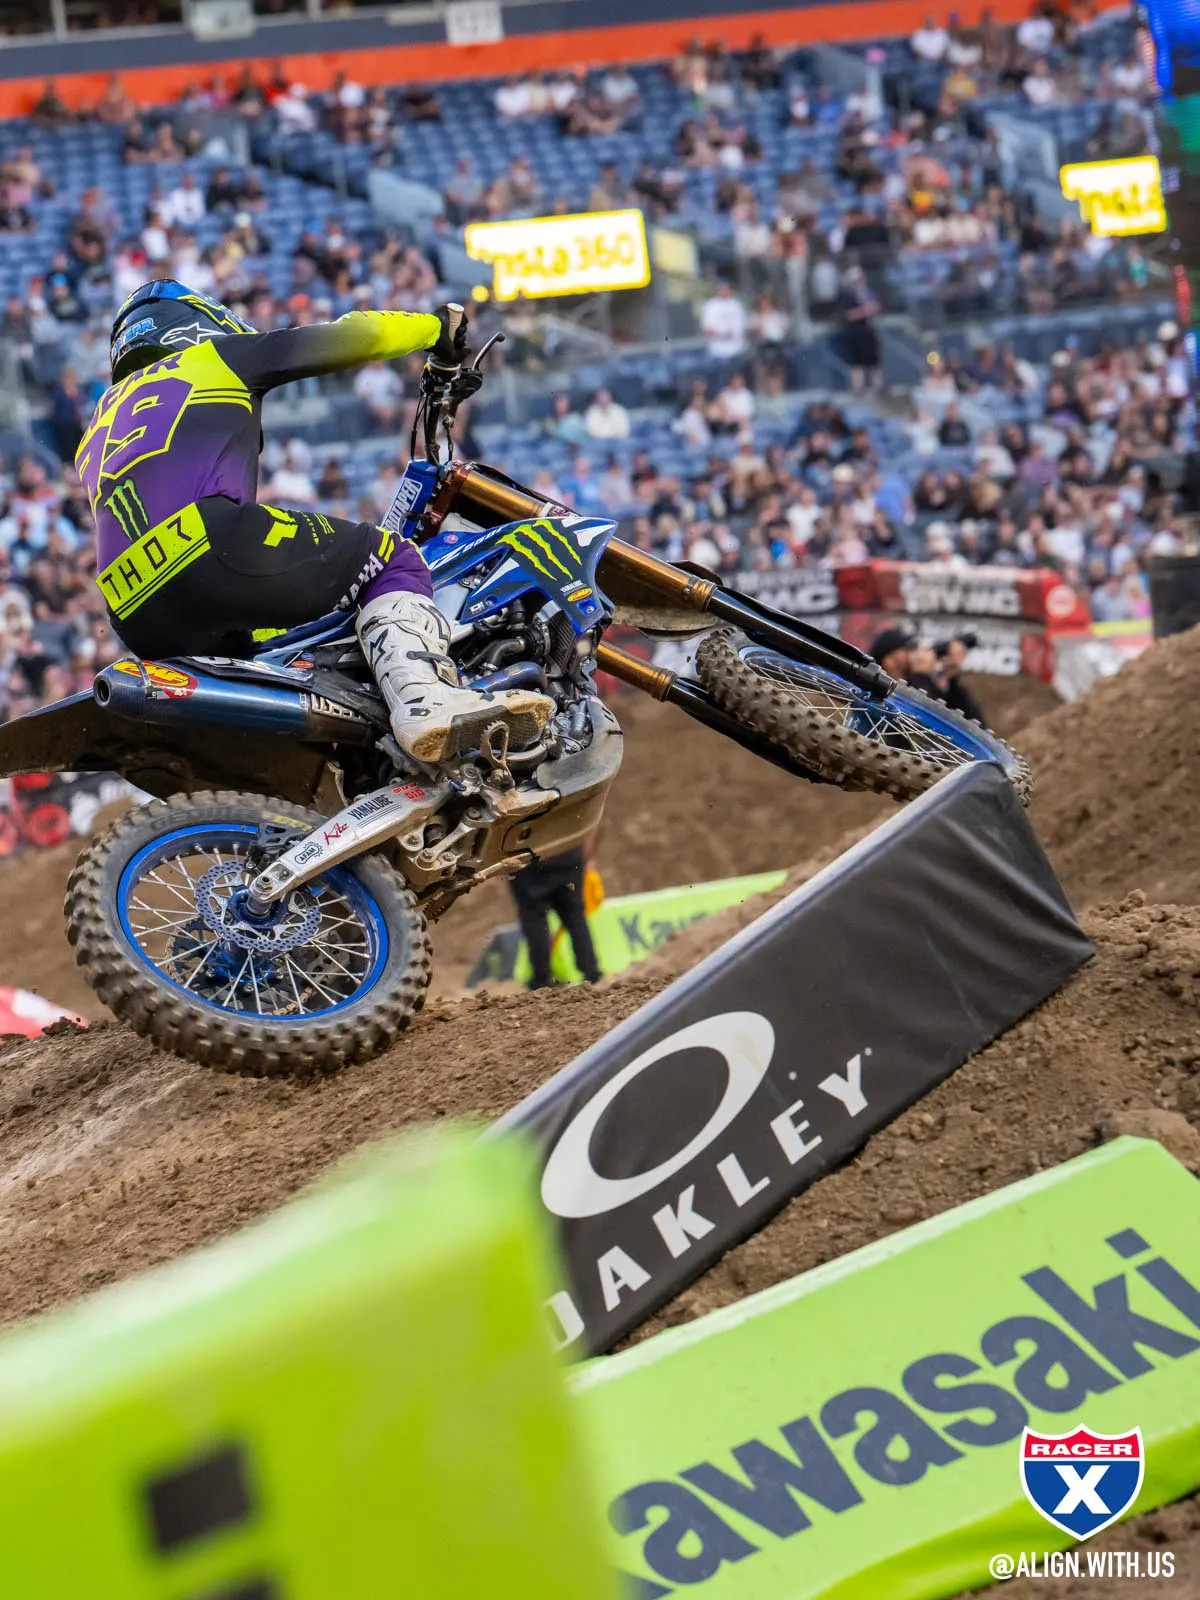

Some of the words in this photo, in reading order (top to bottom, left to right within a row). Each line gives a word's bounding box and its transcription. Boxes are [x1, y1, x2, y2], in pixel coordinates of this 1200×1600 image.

[347, 794, 393, 820] YAMALUBE
[299, 847, 317, 863] AFAM
[608, 1228, 1200, 1600] awasaki
